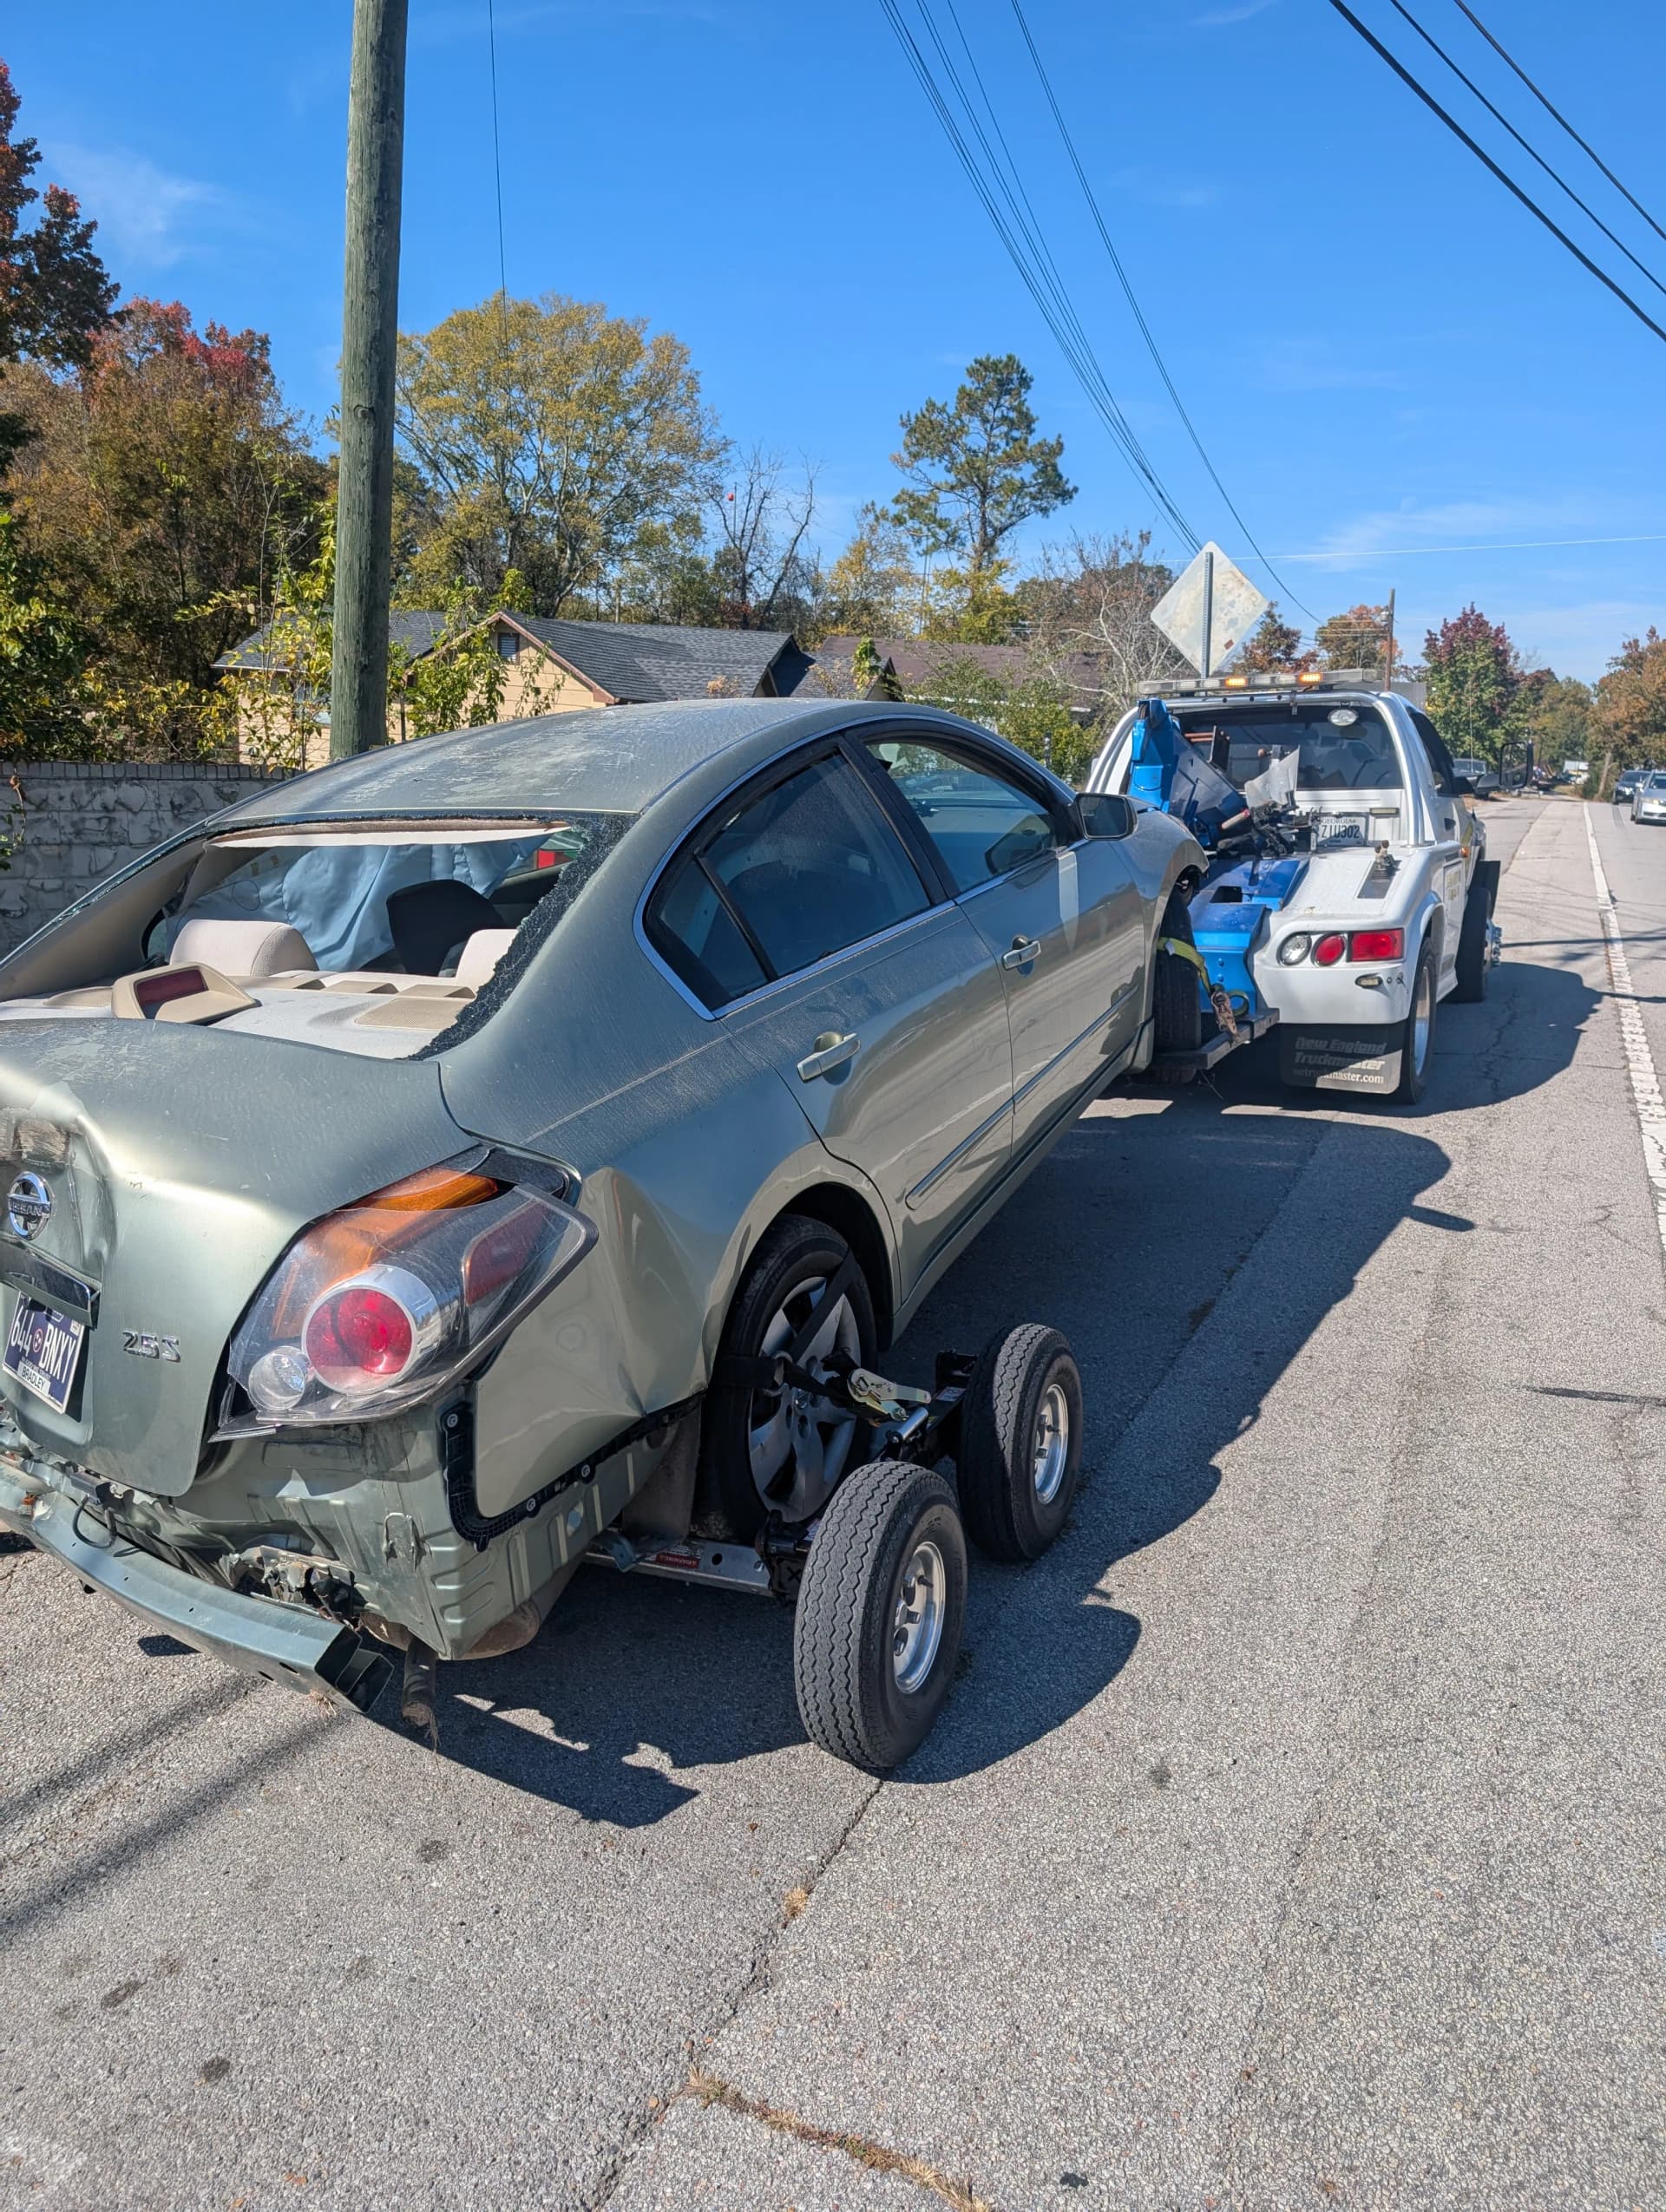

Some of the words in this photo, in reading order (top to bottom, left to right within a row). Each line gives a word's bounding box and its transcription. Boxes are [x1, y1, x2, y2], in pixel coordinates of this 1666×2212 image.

[1330, 1040, 1387, 1055] England
[10, 1305, 35, 1357] 644
[39, 1323, 76, 1384] BNXY
[22, 1366, 45, 1389] BRADLEY
